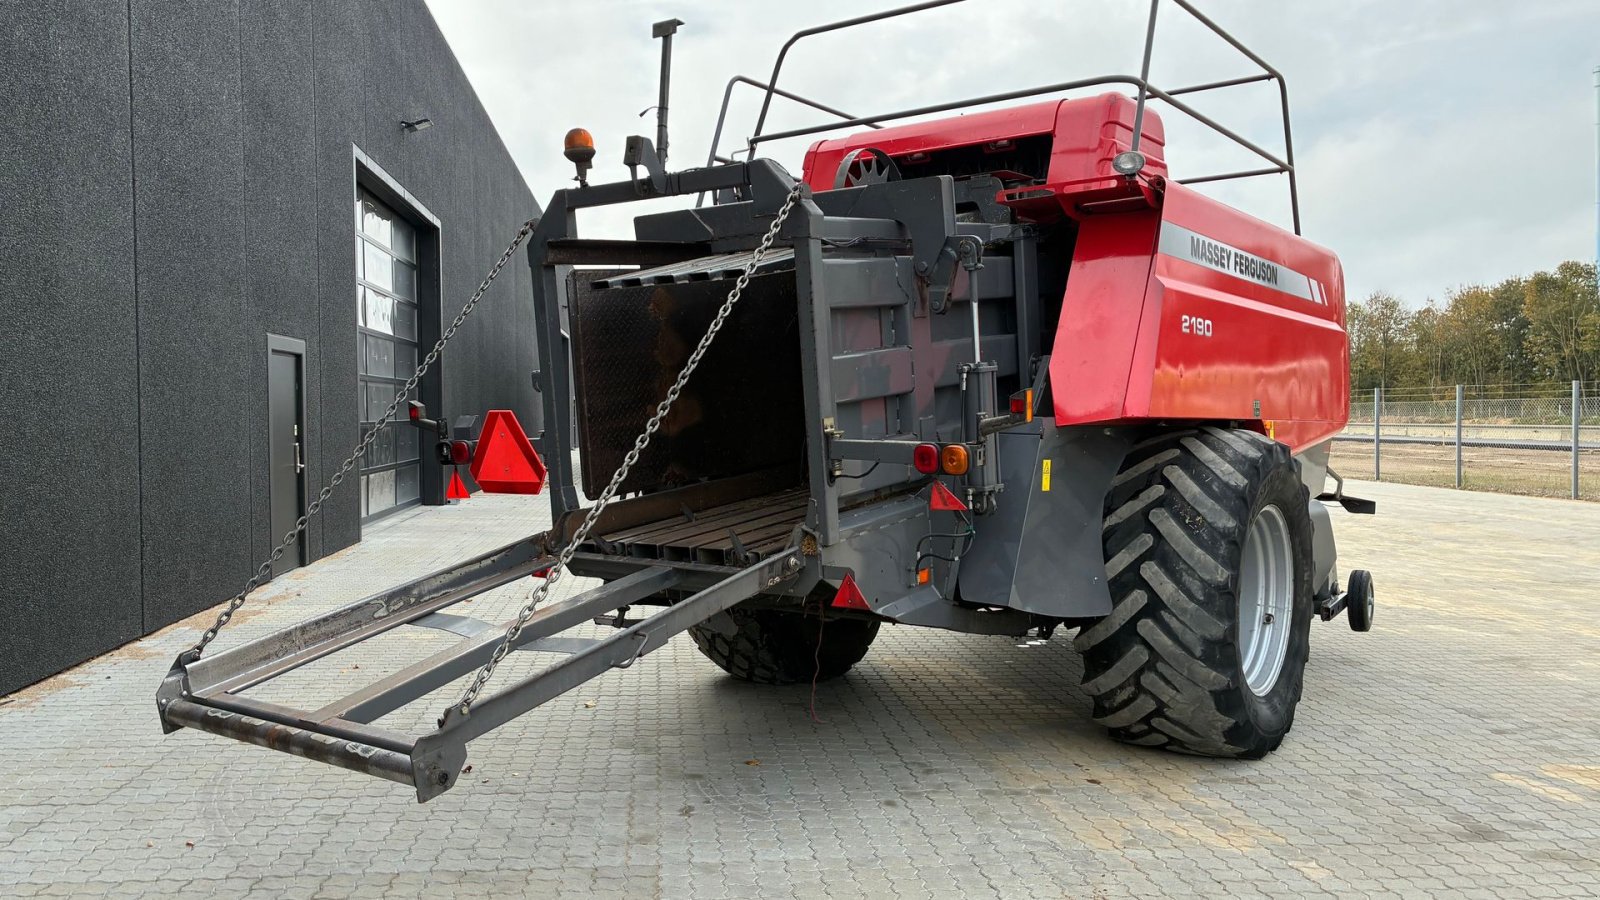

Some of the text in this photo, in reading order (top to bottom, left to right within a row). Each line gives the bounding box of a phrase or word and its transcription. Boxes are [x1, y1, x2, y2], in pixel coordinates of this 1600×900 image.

[1191, 236, 1278, 285] MASSEY FERGUSON
[1182, 315, 1213, 337] 2190
